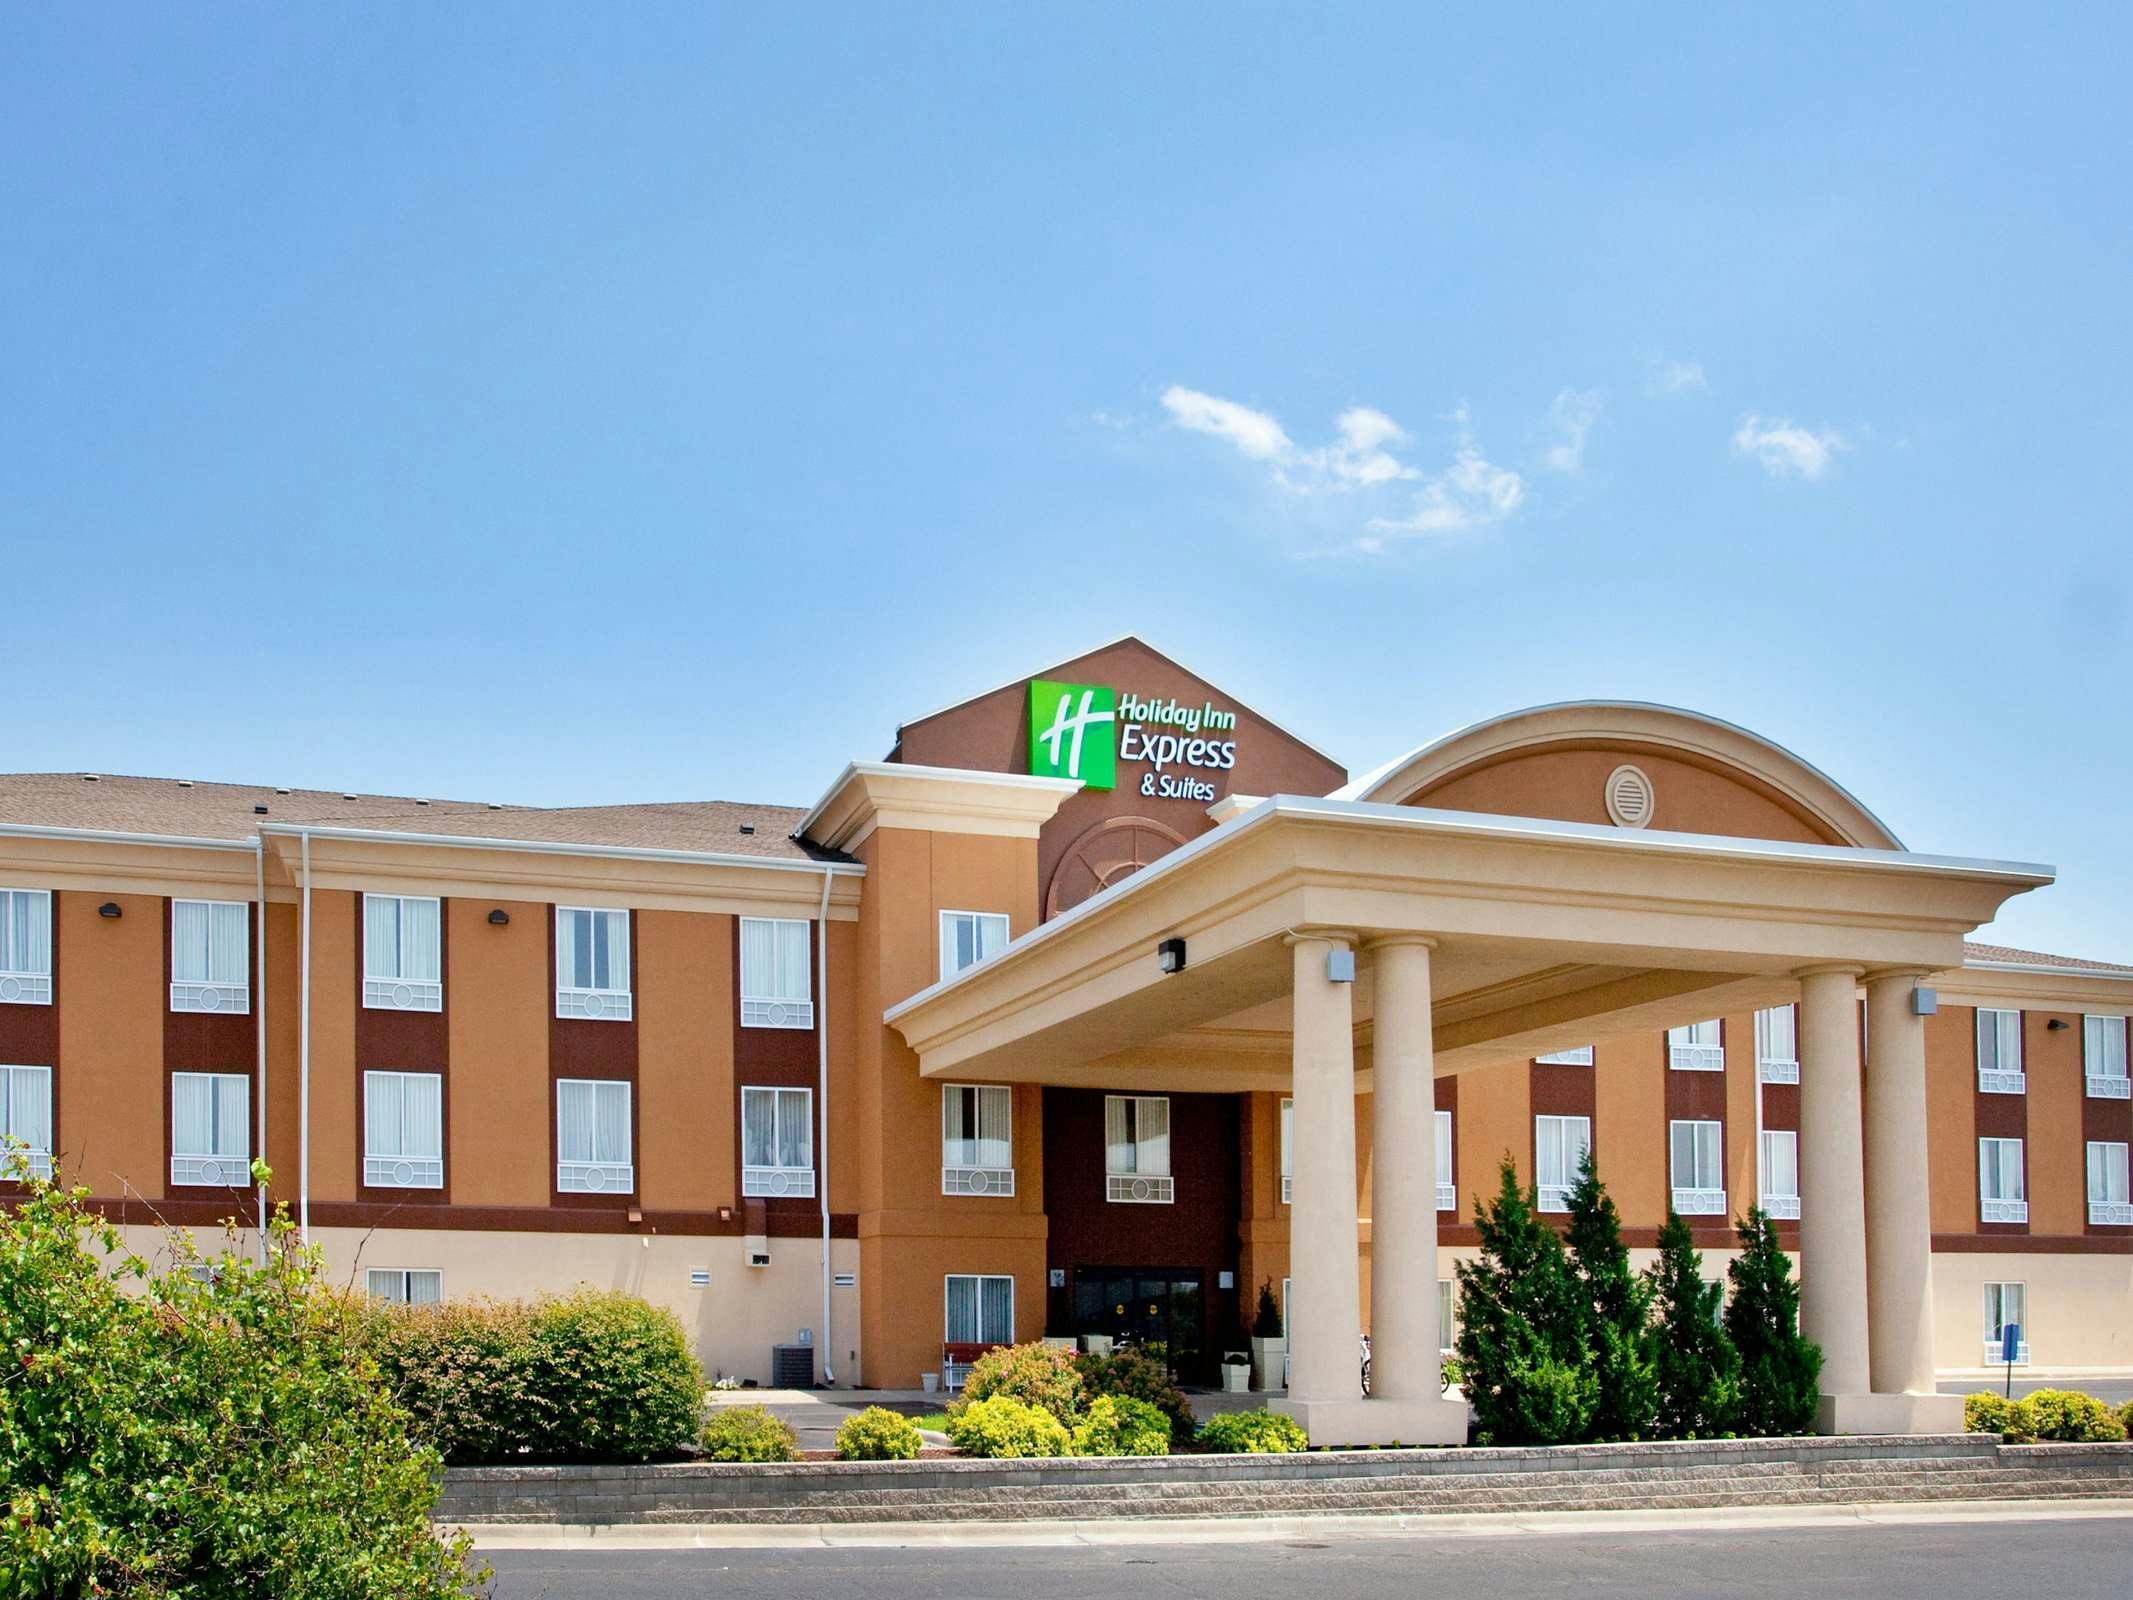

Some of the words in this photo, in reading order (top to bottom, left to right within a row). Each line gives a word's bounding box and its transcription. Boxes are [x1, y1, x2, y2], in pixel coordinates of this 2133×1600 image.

[1039, 690, 1115, 778] H
[1118, 693, 1200, 732] Holiday
[1203, 702, 1236, 730] Inn
[1119, 723, 1236, 772] Express
[1141, 773, 1155, 796] &
[1158, 774, 1215, 801] Suites
